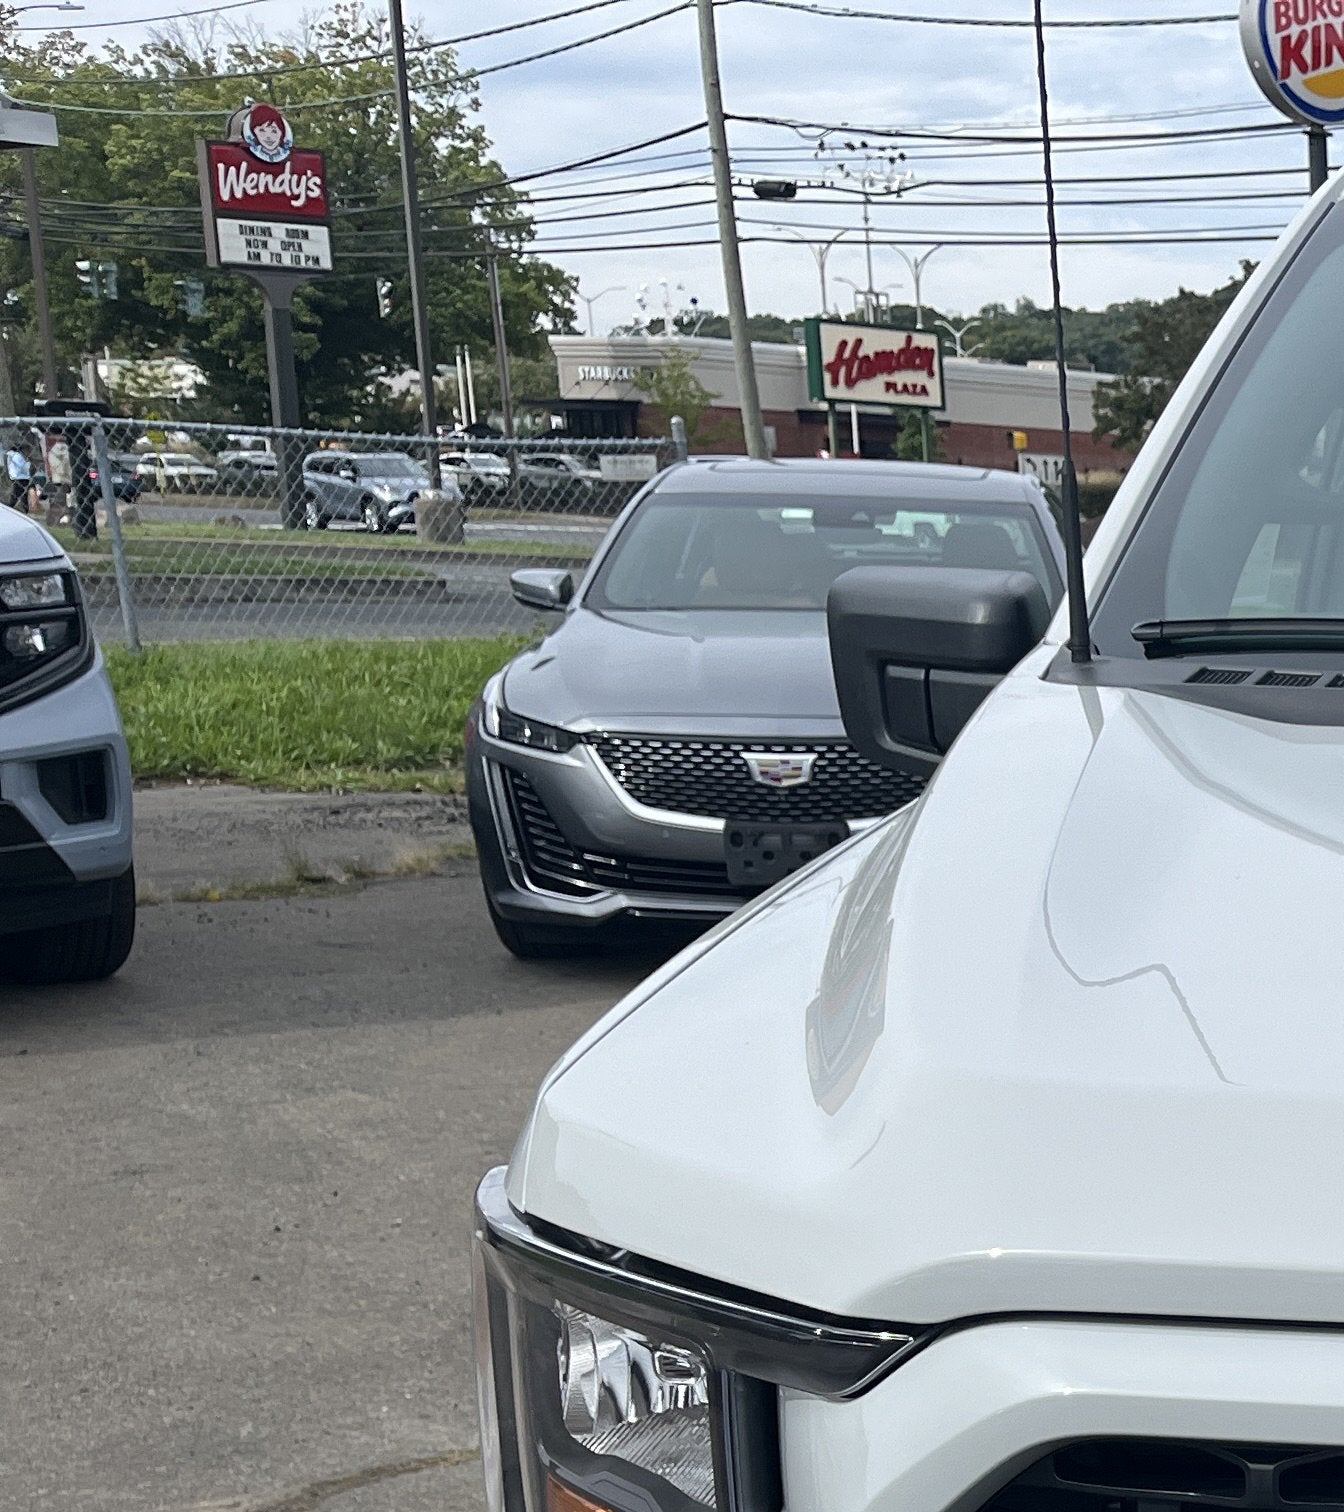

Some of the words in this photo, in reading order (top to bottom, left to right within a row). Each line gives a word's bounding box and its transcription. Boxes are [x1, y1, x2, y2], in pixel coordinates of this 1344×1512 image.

[217, 161, 321, 207] Wendy's
[245, 238, 268, 250] NOW
[247, 250, 261, 262] AM
[270, 251, 282, 264] TO
[825, 334, 935, 389] Hamden
[884, 381, 929, 397] PLAZA
